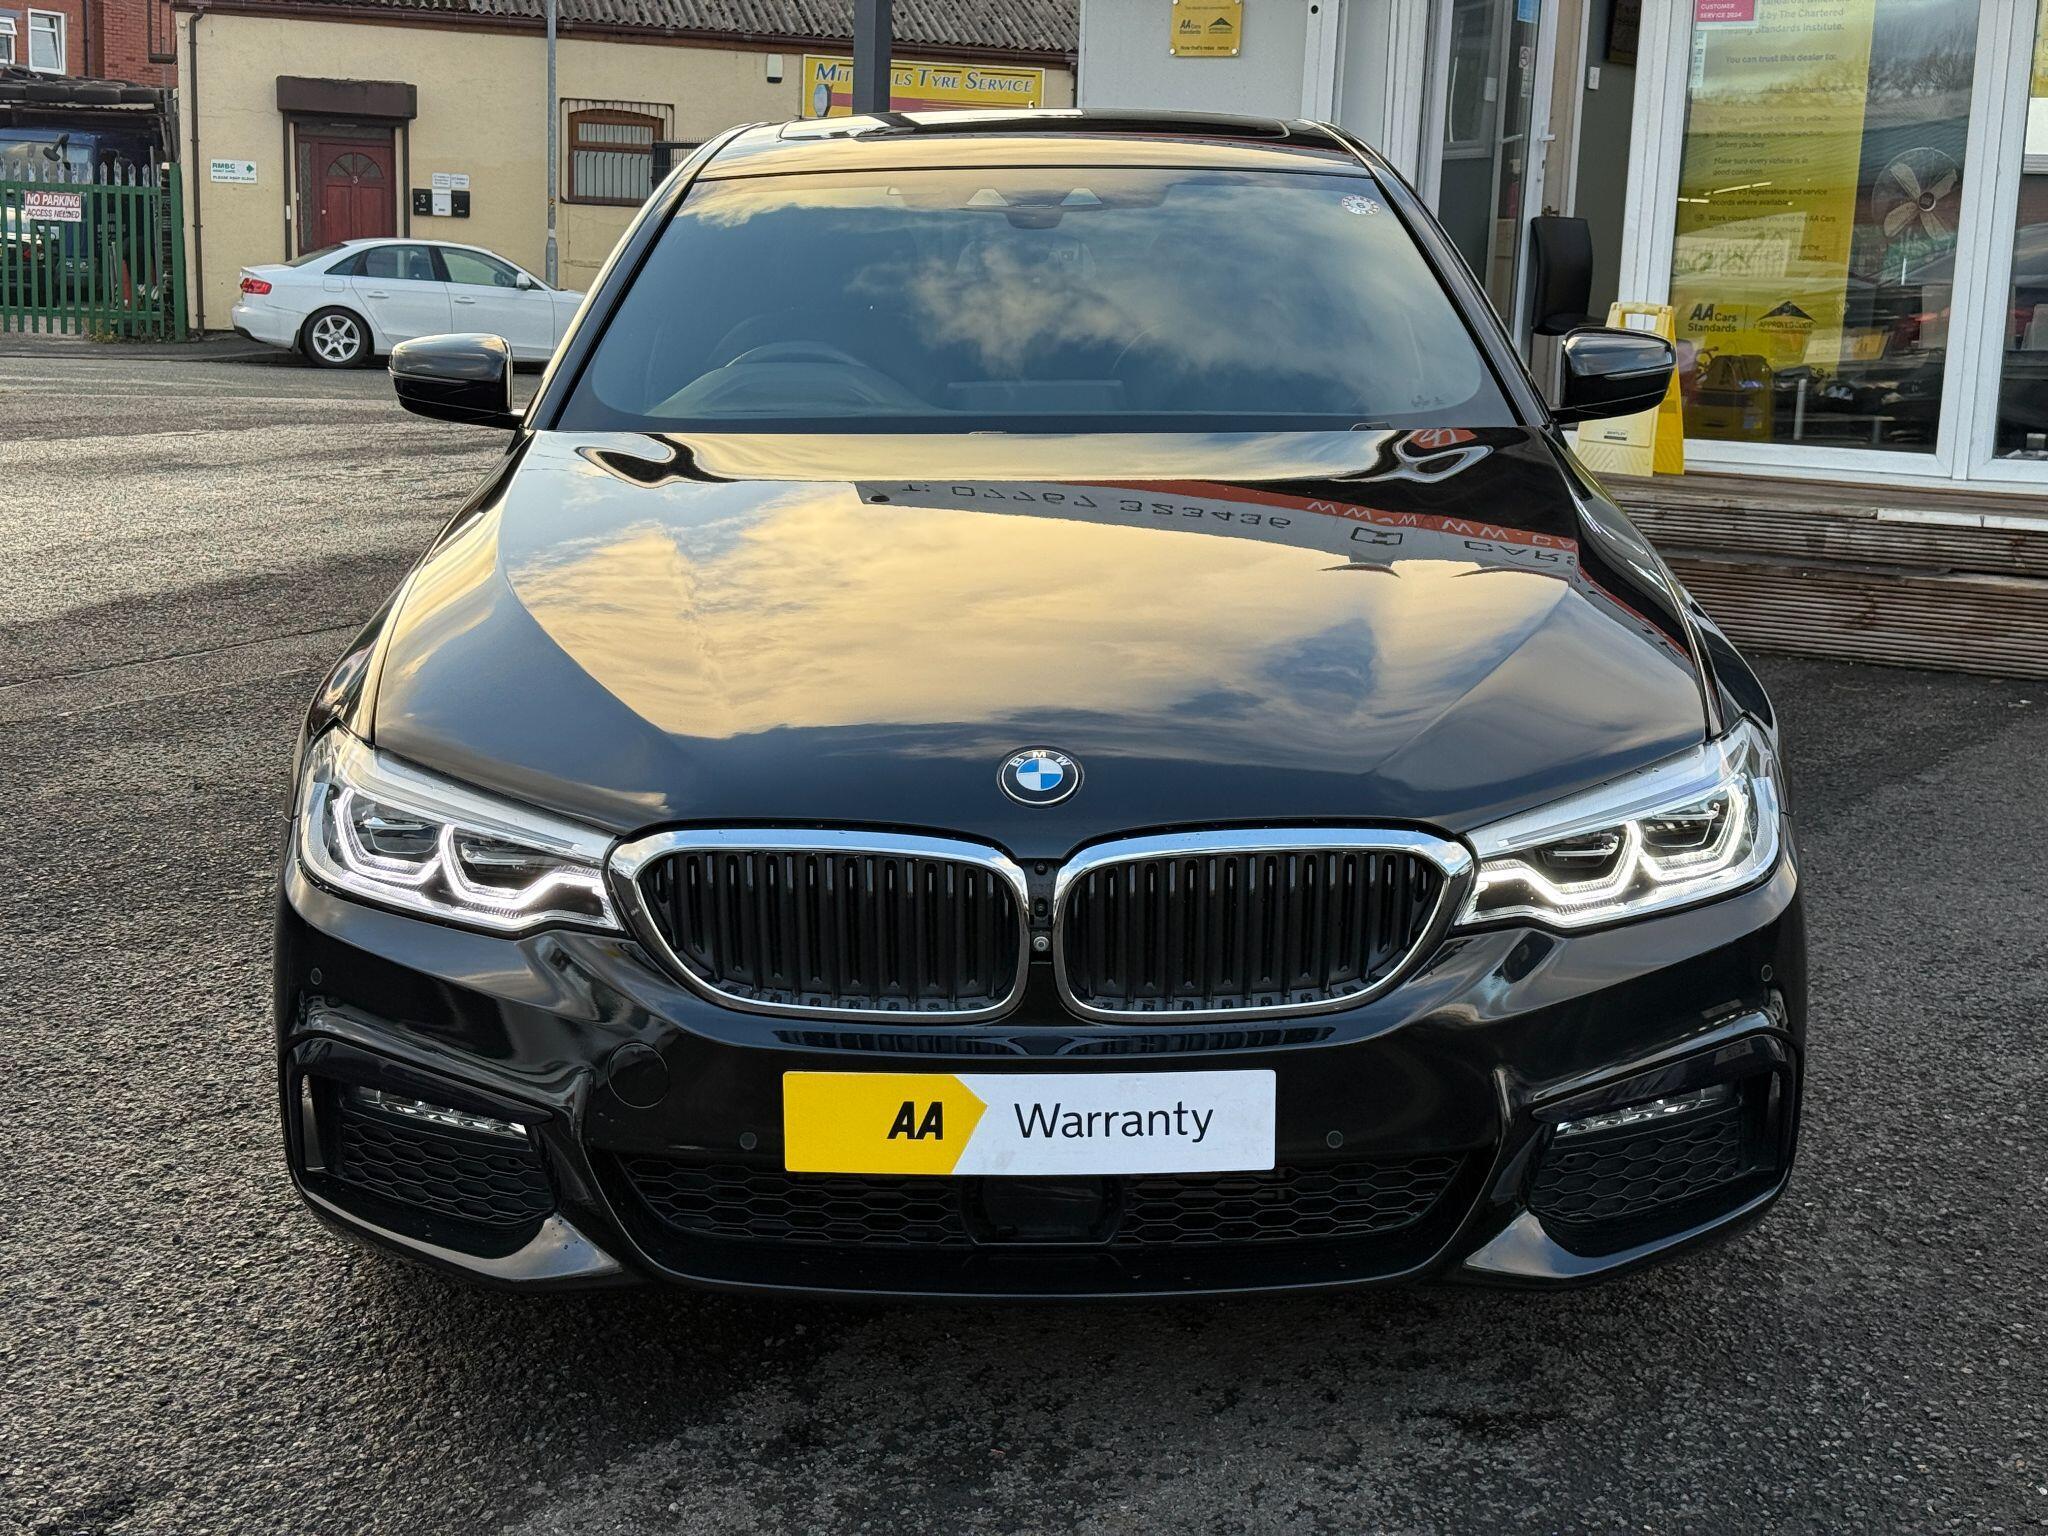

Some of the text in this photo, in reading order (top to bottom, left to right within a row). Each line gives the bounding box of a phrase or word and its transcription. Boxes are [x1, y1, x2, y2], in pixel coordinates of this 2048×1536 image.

[1780, 10, 1796, 18] The
[1798, 8, 1845, 18] Chartered
[1755, 25, 1801, 34] Standards
[1726, 56, 1740, 64] You
[918, 69, 959, 89] TYRE
[965, 71, 1033, 93] SERVICE
[212, 162, 236, 170] RMBC
[26, 193, 80, 208] NO PARKING
[420, 194, 426, 204] 3
[26, 208, 53, 218] ACCESS
[1690, 303, 1737, 322] AA Cars
[1688, 322, 1736, 333] Standards
[1009, 751, 1071, 767] BMW
[887, 1100, 1214, 1143] AA Warranty
